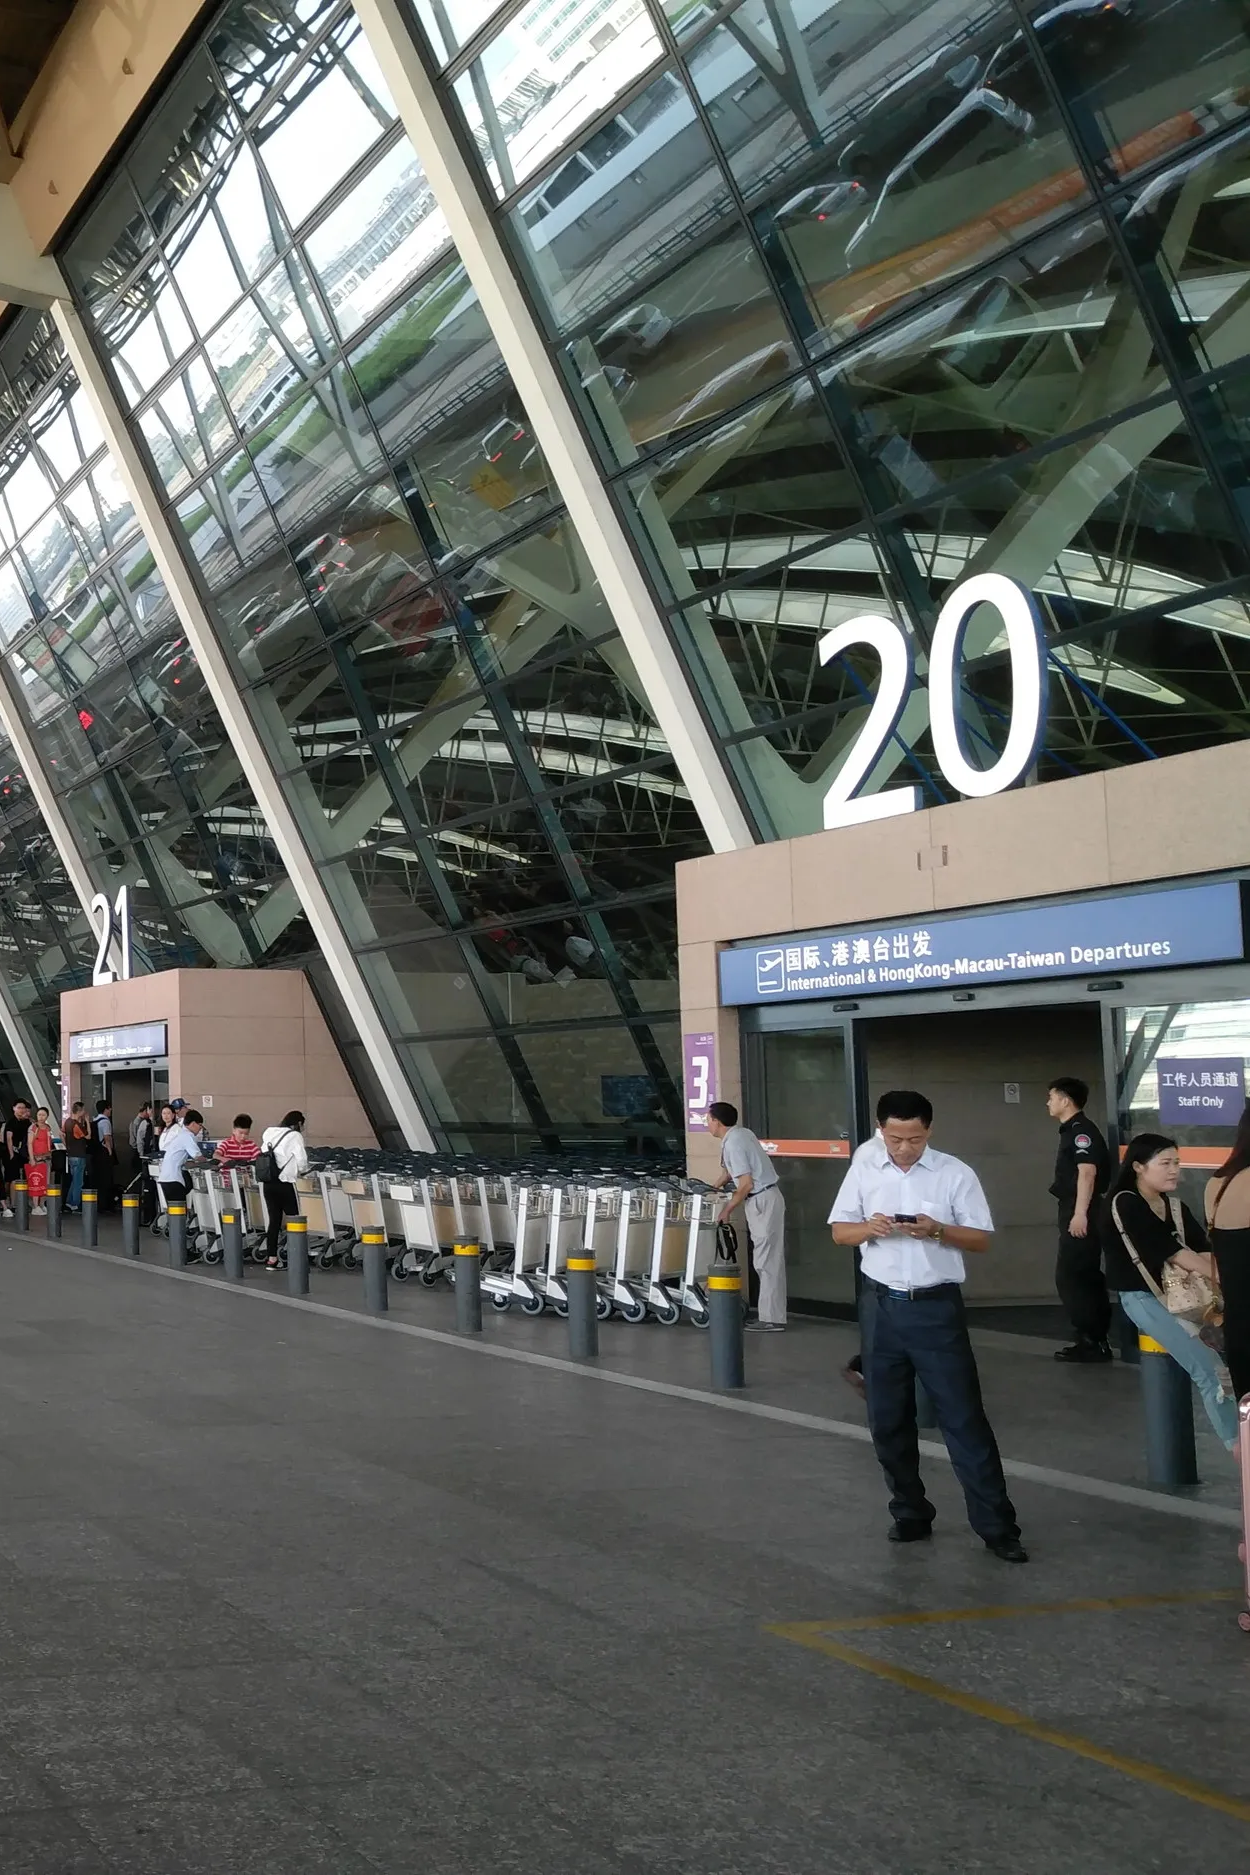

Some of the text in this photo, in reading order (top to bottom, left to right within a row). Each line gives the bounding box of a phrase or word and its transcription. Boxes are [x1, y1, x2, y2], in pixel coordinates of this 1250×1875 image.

[818, 572, 1044, 831] 20
[91, 885, 131, 986] 21
[785, 930, 933, 973] 国际、港澳台出发
[786, 940, 1171, 992] International & HongKong-Macau-Taiwan Departures
[689, 1056, 709, 1109] 3
[1162, 1072, 1239, 1087] 工作人员通道
[1178, 1096, 1224, 1109] Staff Only
